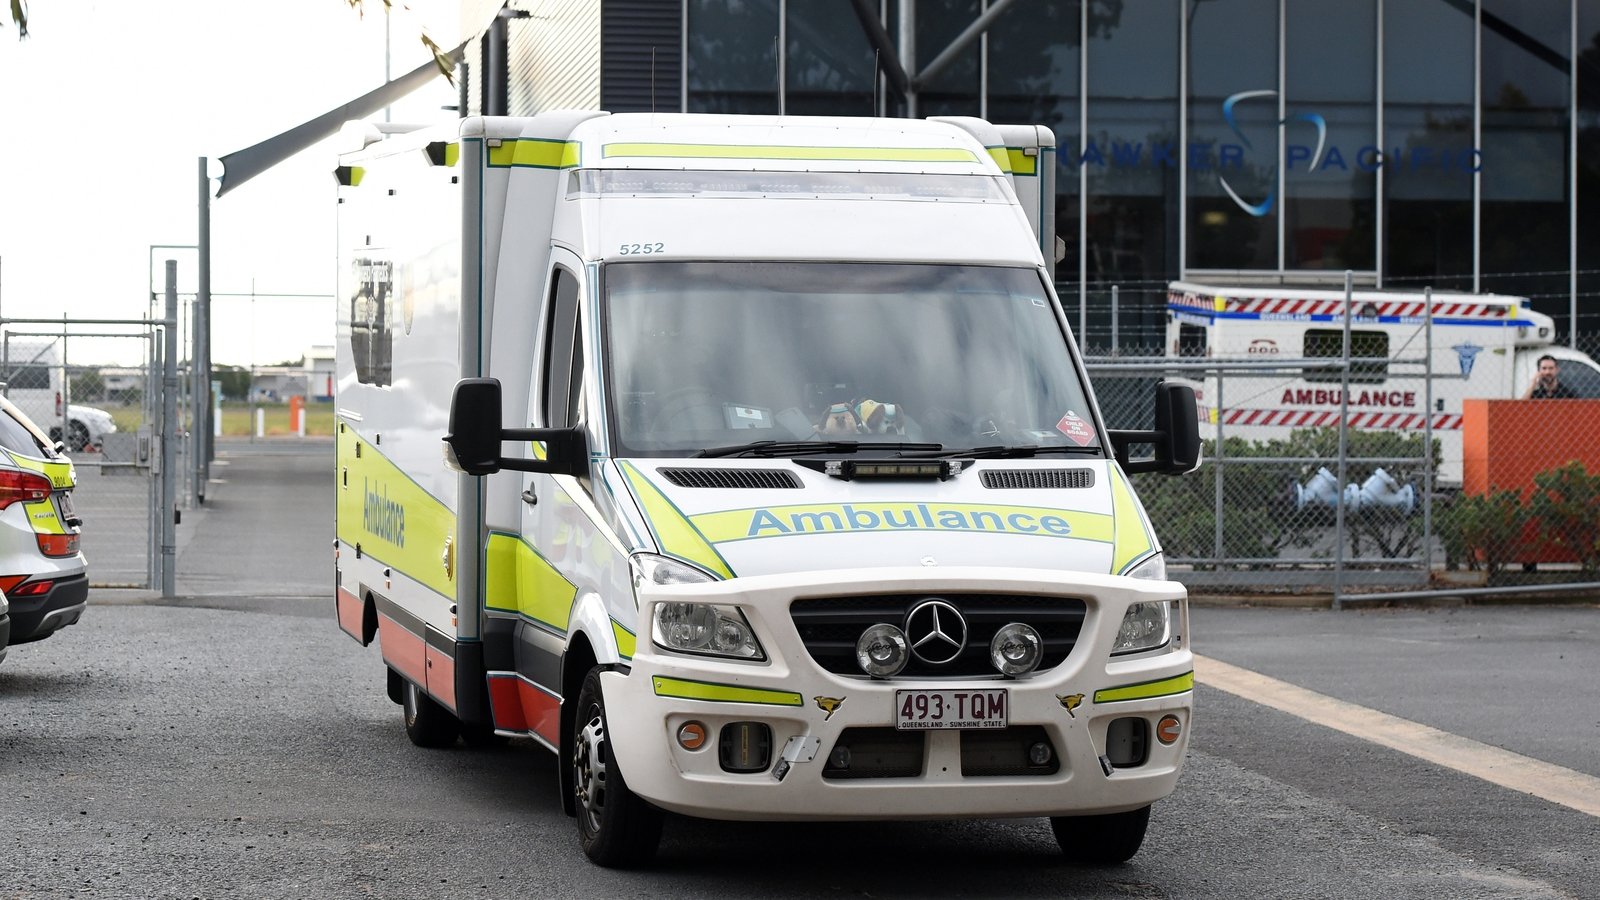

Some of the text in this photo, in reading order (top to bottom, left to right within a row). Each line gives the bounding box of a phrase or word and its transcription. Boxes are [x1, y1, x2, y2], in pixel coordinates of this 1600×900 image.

[1286, 145, 1482, 173] PACIFIC
[619, 242, 665, 256] 5252
[1281, 388, 1416, 407] AMBULANCE
[363, 475, 405, 549] Ambulance
[747, 504, 1072, 536] Ambulance
